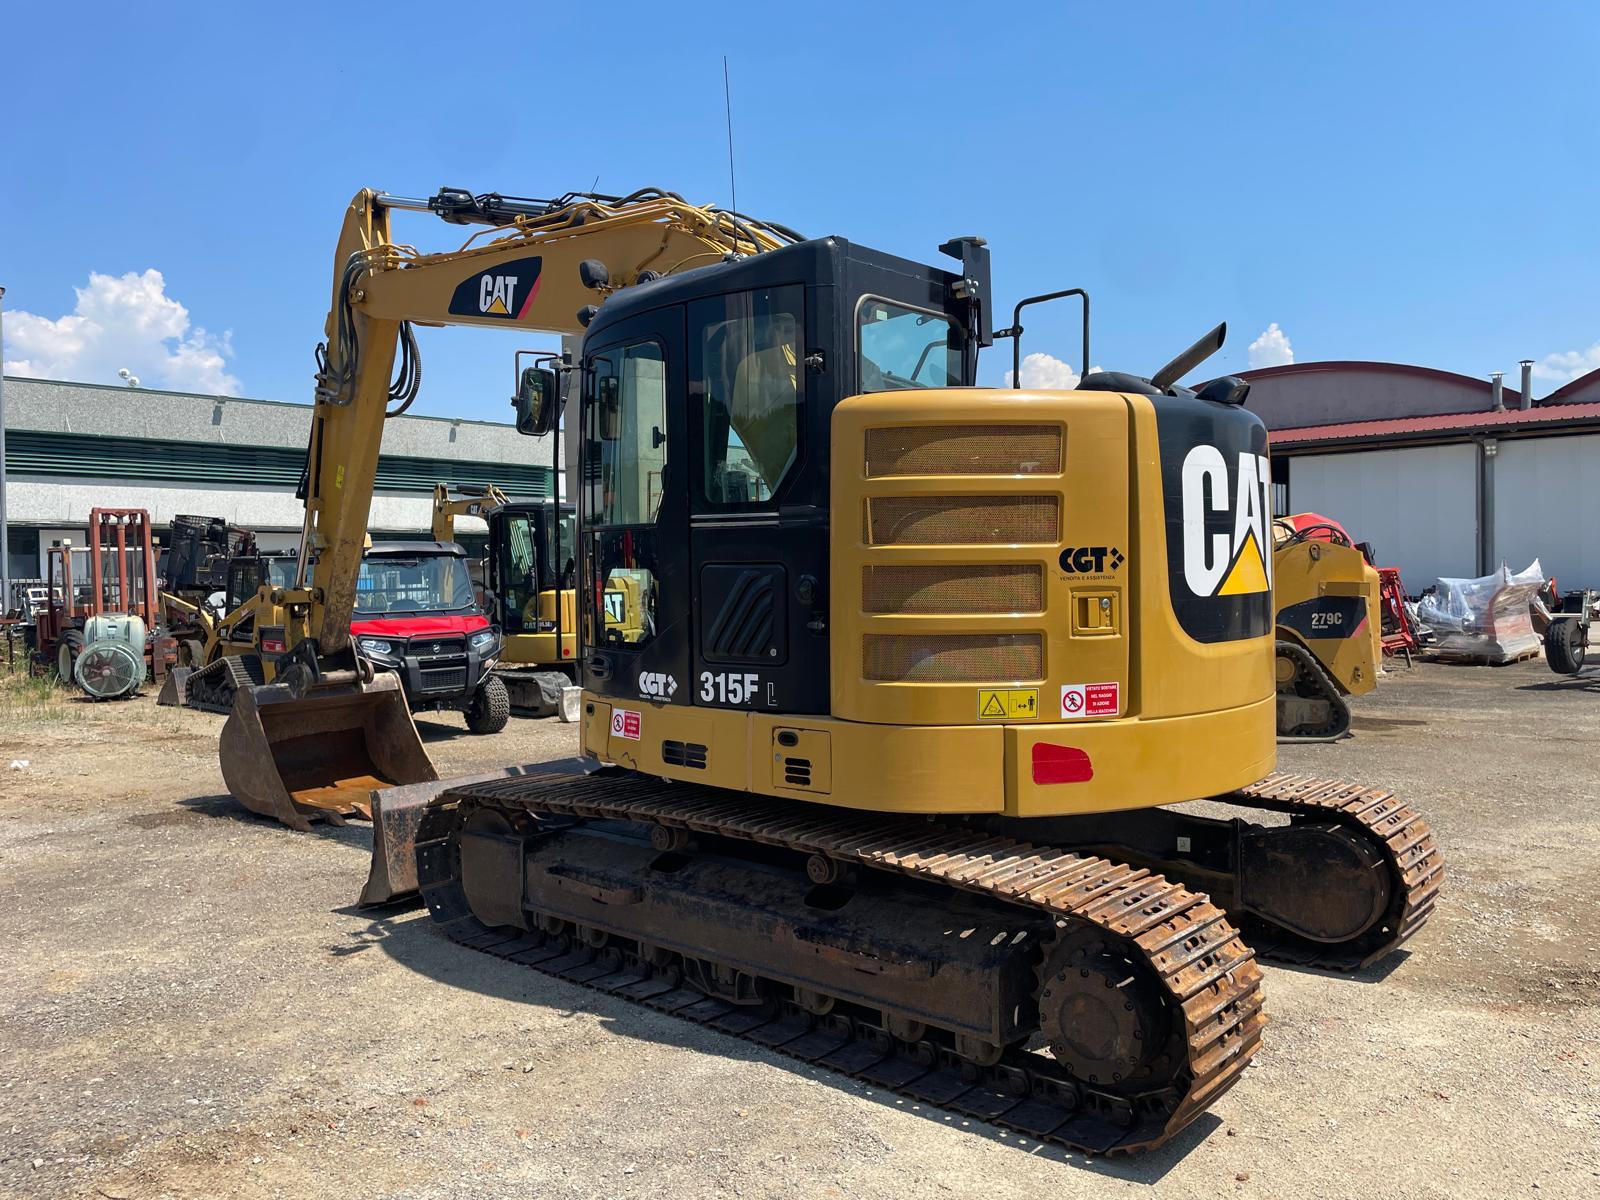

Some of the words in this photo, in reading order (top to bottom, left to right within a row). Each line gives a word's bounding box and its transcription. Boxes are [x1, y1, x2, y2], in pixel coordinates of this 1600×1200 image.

[479, 274, 518, 314] CAT
[1182, 444, 1272, 597] CAT
[1058, 546, 1108, 573] CGT
[604, 594, 623, 623] AT
[1311, 612, 1343, 625] 279C
[638, 671, 667, 696] CGT
[700, 671, 759, 704] 315F
